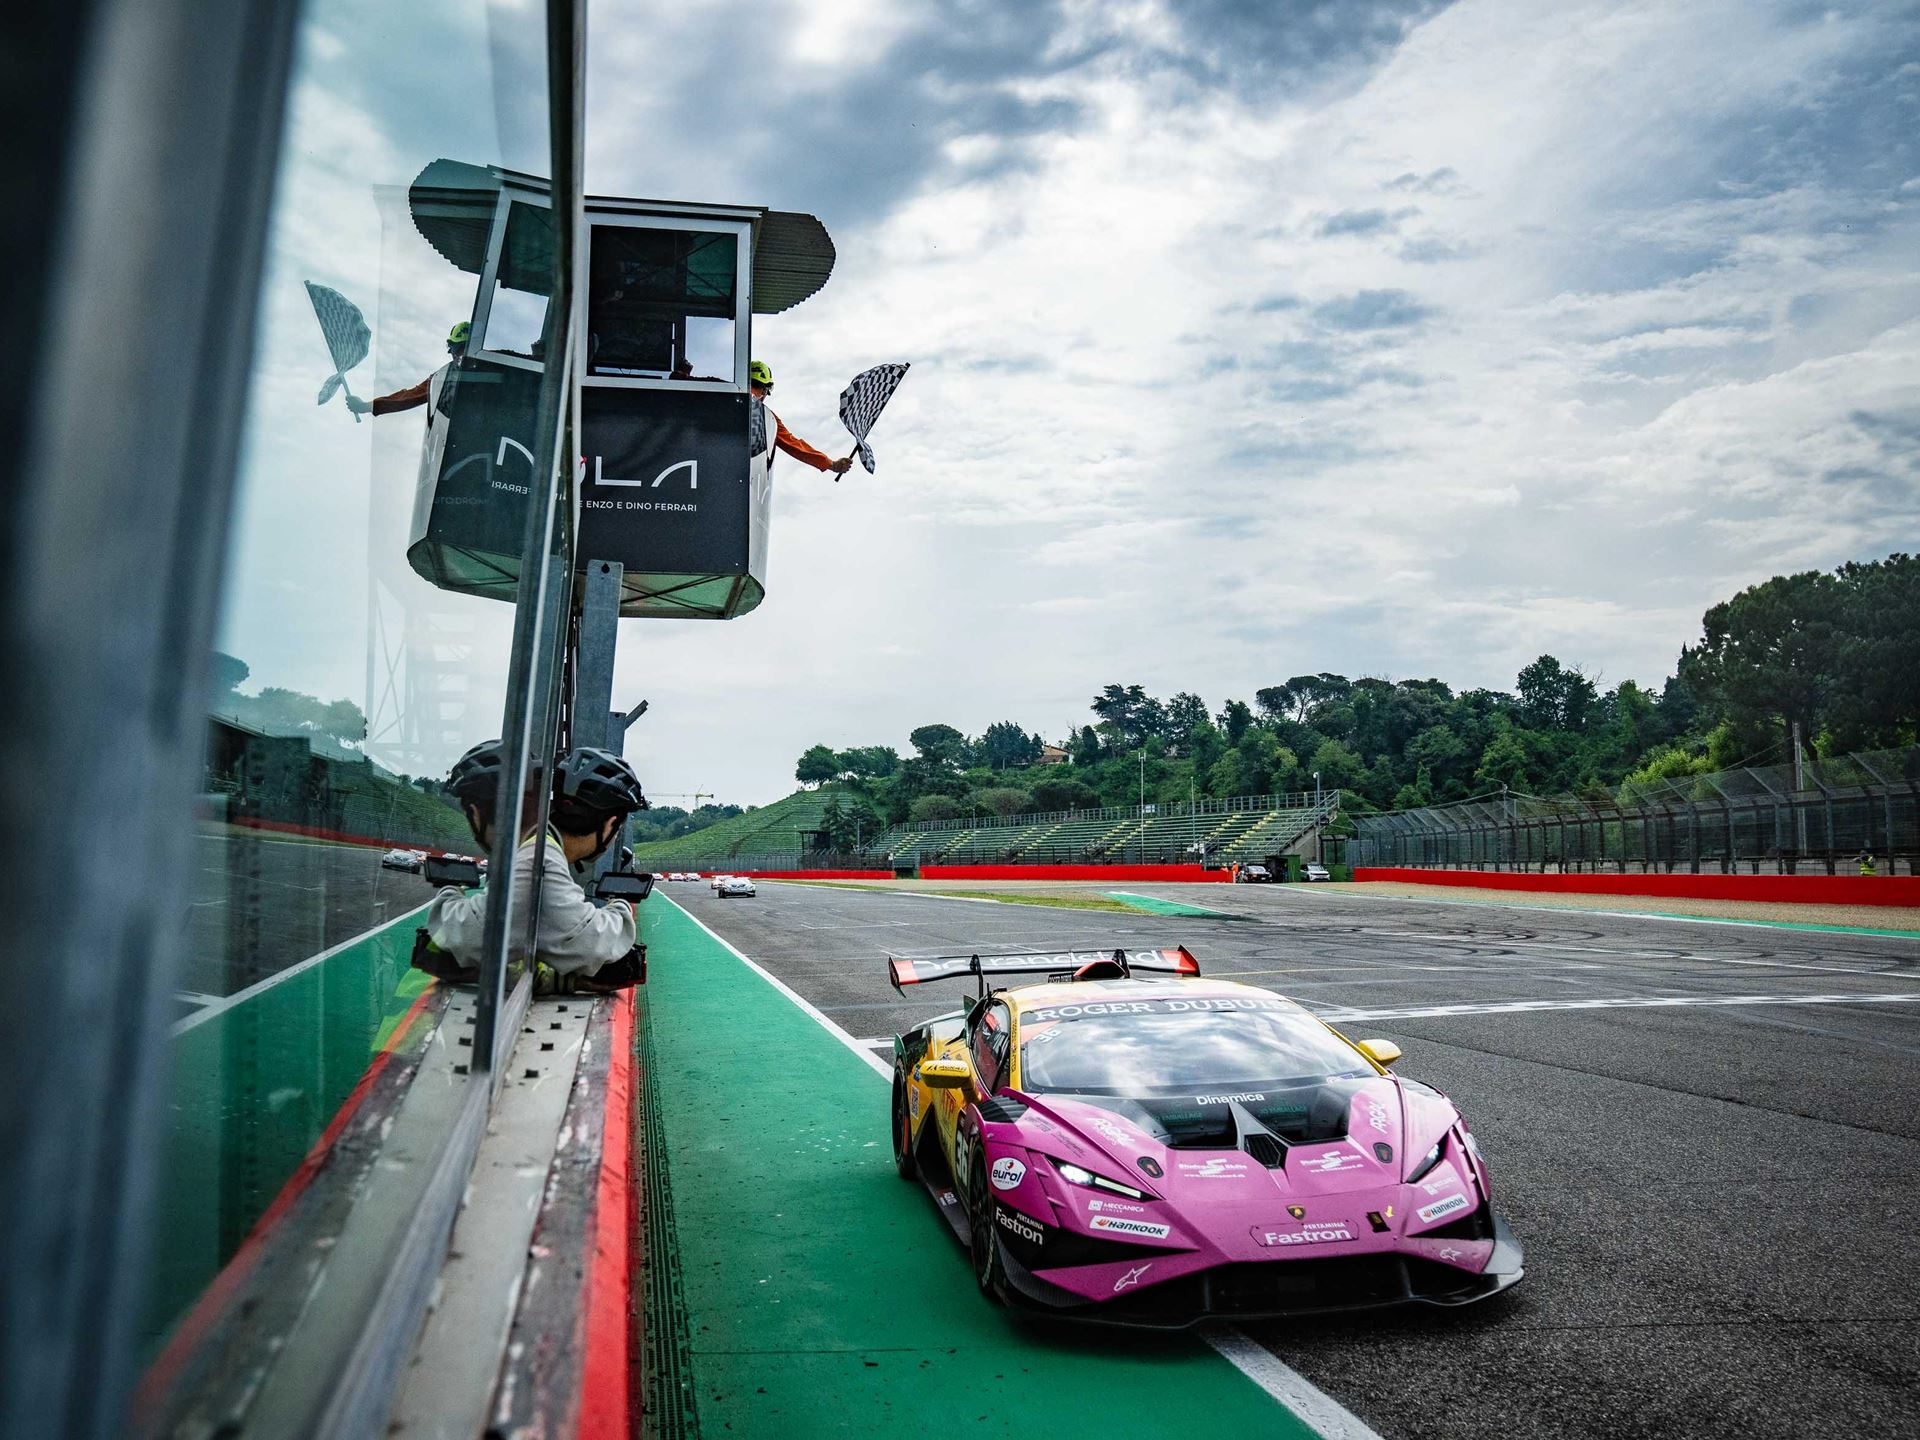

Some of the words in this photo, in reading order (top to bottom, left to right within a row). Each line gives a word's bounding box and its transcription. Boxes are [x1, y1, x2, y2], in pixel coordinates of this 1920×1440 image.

[586, 500, 614, 509] ENZO
[616, 501, 623, 510] E
[625, 501, 652, 511] DINO
[654, 503, 697, 512] FERRARI
[1034, 1000, 1155, 1022] ROGER
[1160, 999, 1292, 1013] DUBUIS
[1195, 1092, 1265, 1106] Dinamica
[992, 1169, 1022, 1183] eurol
[995, 1206, 1044, 1246] Fastron
[1303, 1221, 1347, 1231] PERTAMINA
[1264, 1229, 1351, 1246] Fastron
